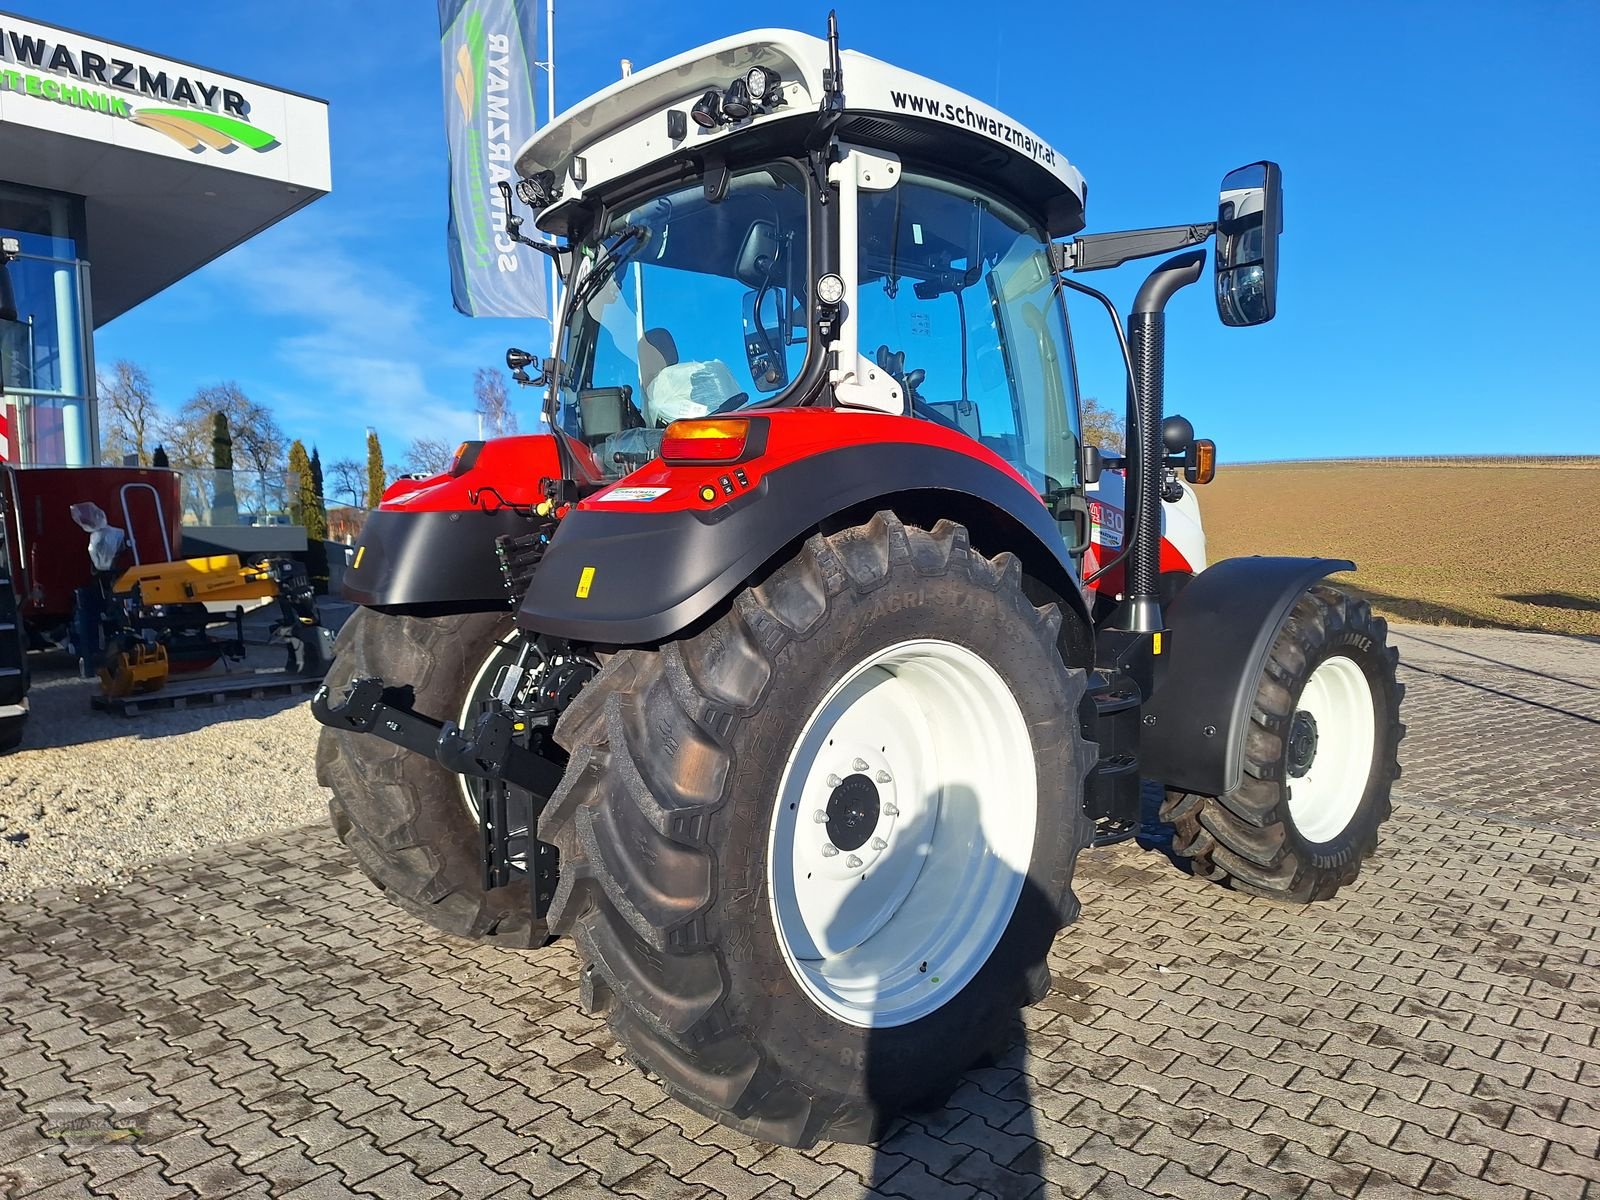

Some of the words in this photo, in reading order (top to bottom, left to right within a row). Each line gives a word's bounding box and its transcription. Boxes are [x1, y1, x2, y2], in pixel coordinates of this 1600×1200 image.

[0, 27, 245, 116] WARZMAYR
[0, 69, 129, 117] TECHNIK
[890, 90, 1056, 167] www.schwarzmayr.at
